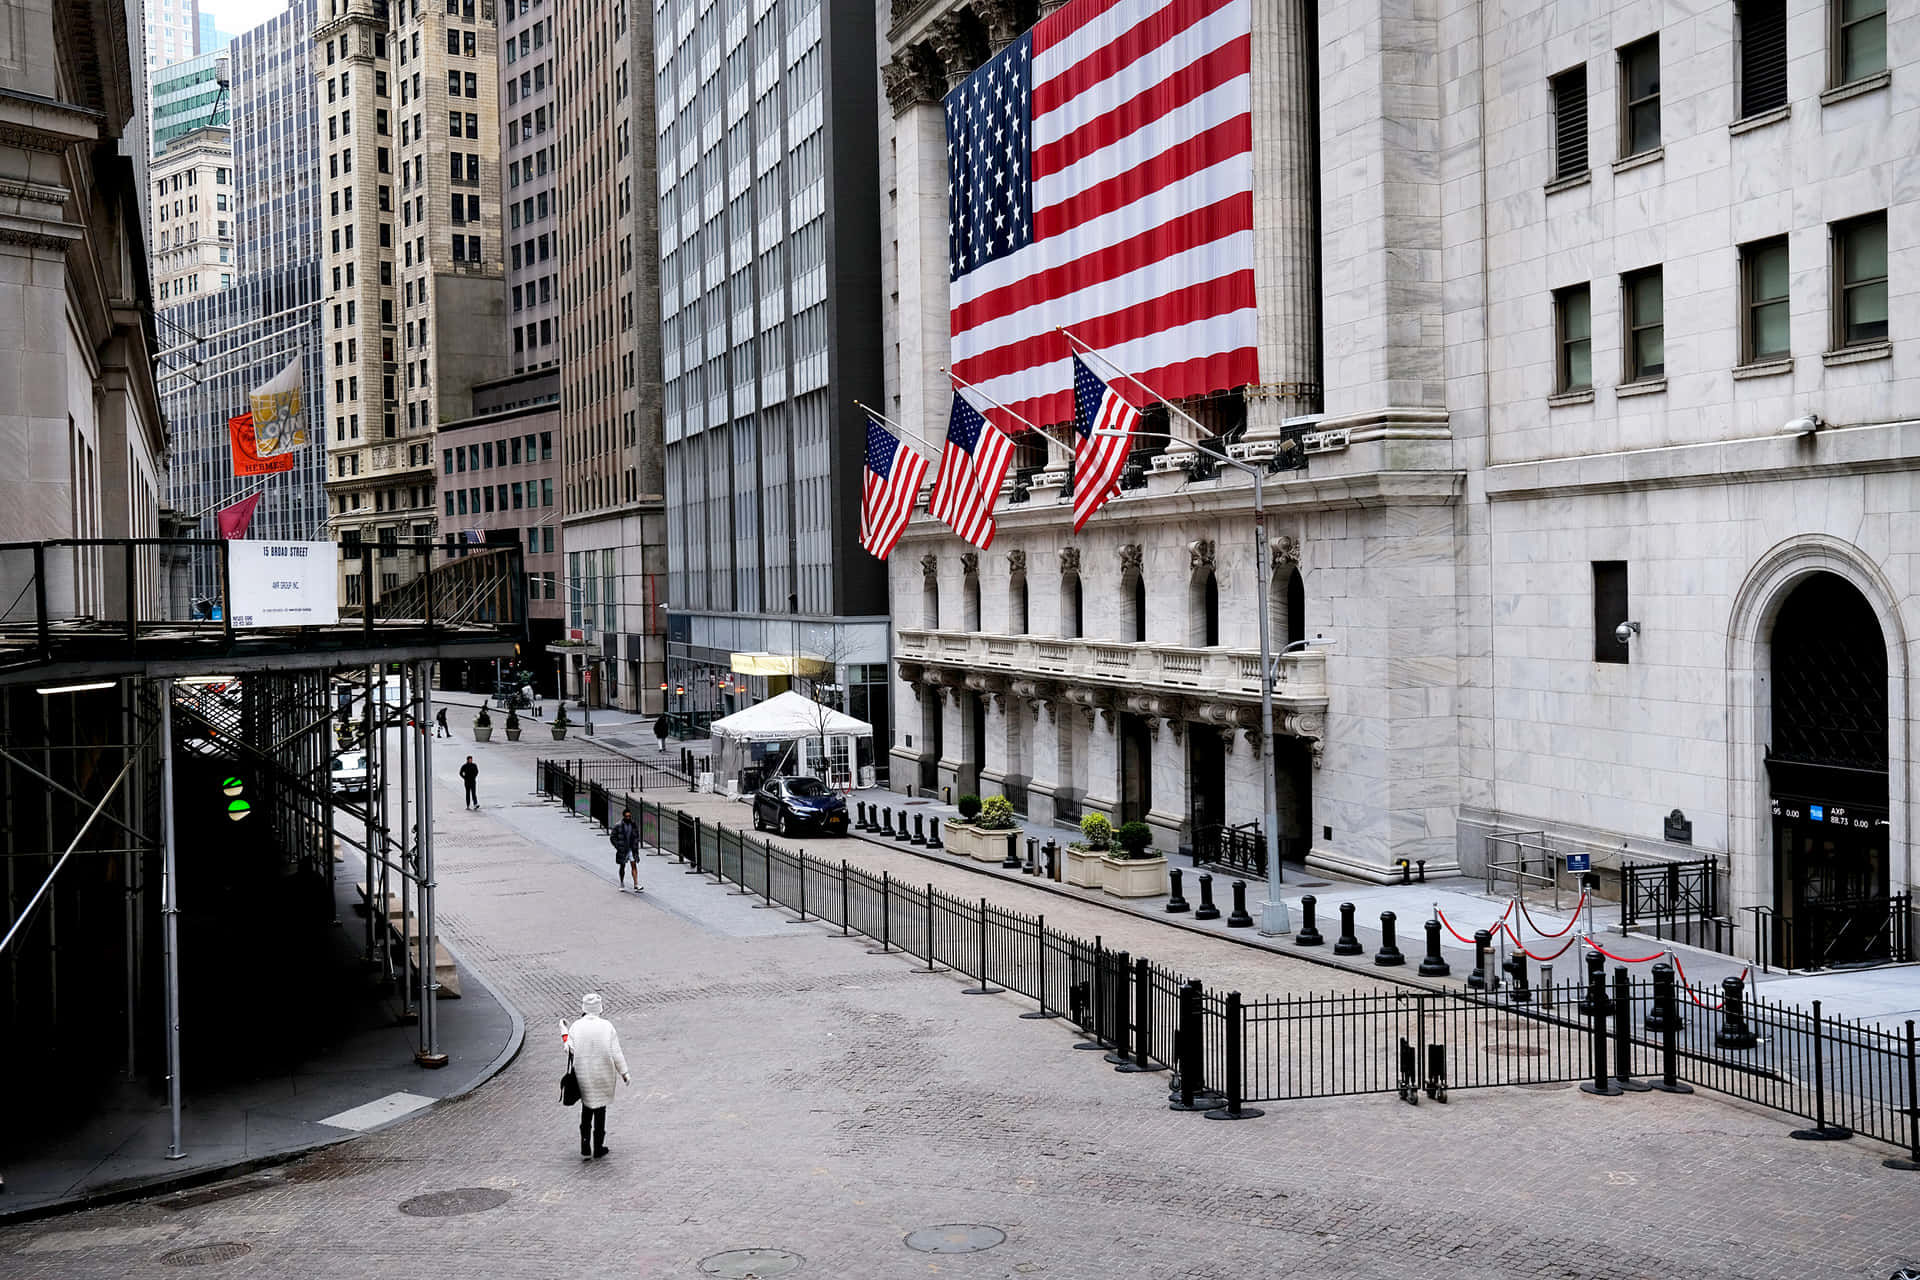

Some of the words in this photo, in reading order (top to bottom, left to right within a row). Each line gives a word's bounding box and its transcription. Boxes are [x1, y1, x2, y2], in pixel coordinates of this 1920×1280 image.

[263, 546, 269, 557] 15
[271, 546, 288, 557] BROAD
[290, 546, 308, 557] STREET
[1785, 809, 1800, 818] 0.00
[1830, 807, 1845, 816] AXP
[1853, 818, 1869, 829] 0.00
